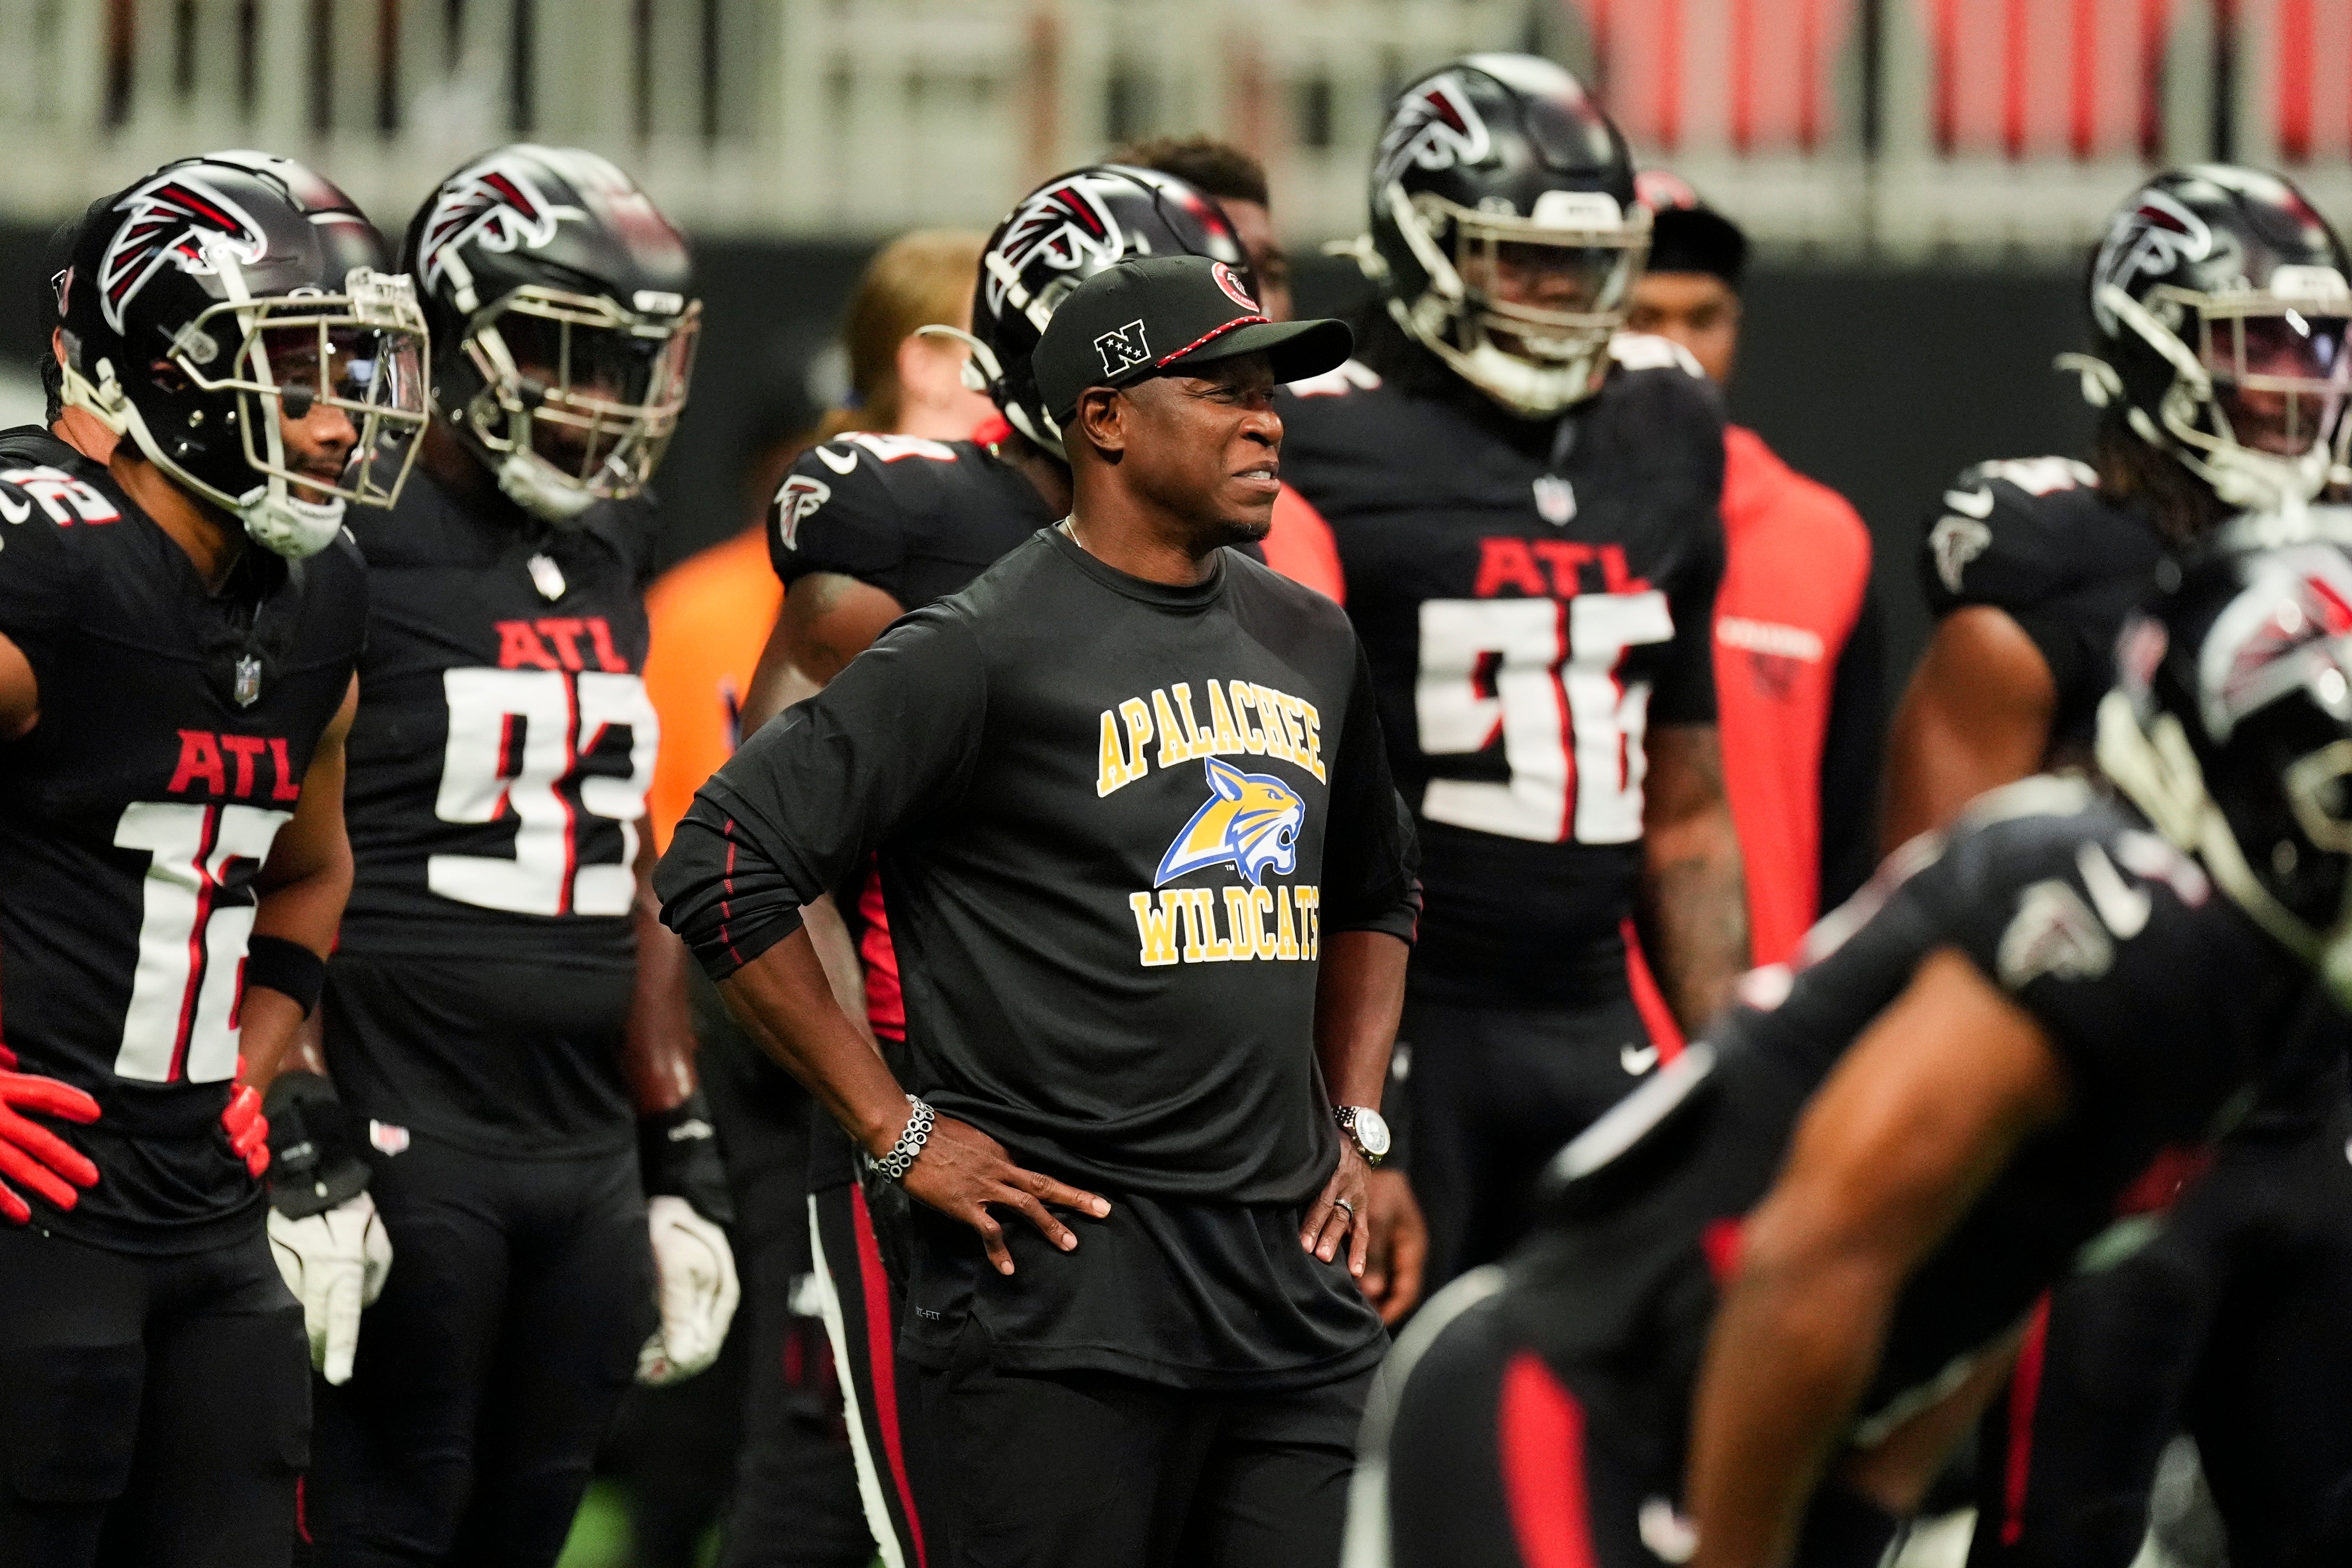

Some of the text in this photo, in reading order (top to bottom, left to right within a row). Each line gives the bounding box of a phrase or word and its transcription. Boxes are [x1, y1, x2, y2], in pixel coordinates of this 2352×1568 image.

[1093, 319, 1151, 377] N
[1473, 536, 1651, 599] ATL
[494, 616, 628, 673] ATL
[1097, 679, 1326, 798] APALACHEE
[1418, 589, 1675, 845] 96
[168, 729, 300, 800] ATL
[427, 667, 661, 916] 93
[1129, 885, 1319, 967] WILDCATS
